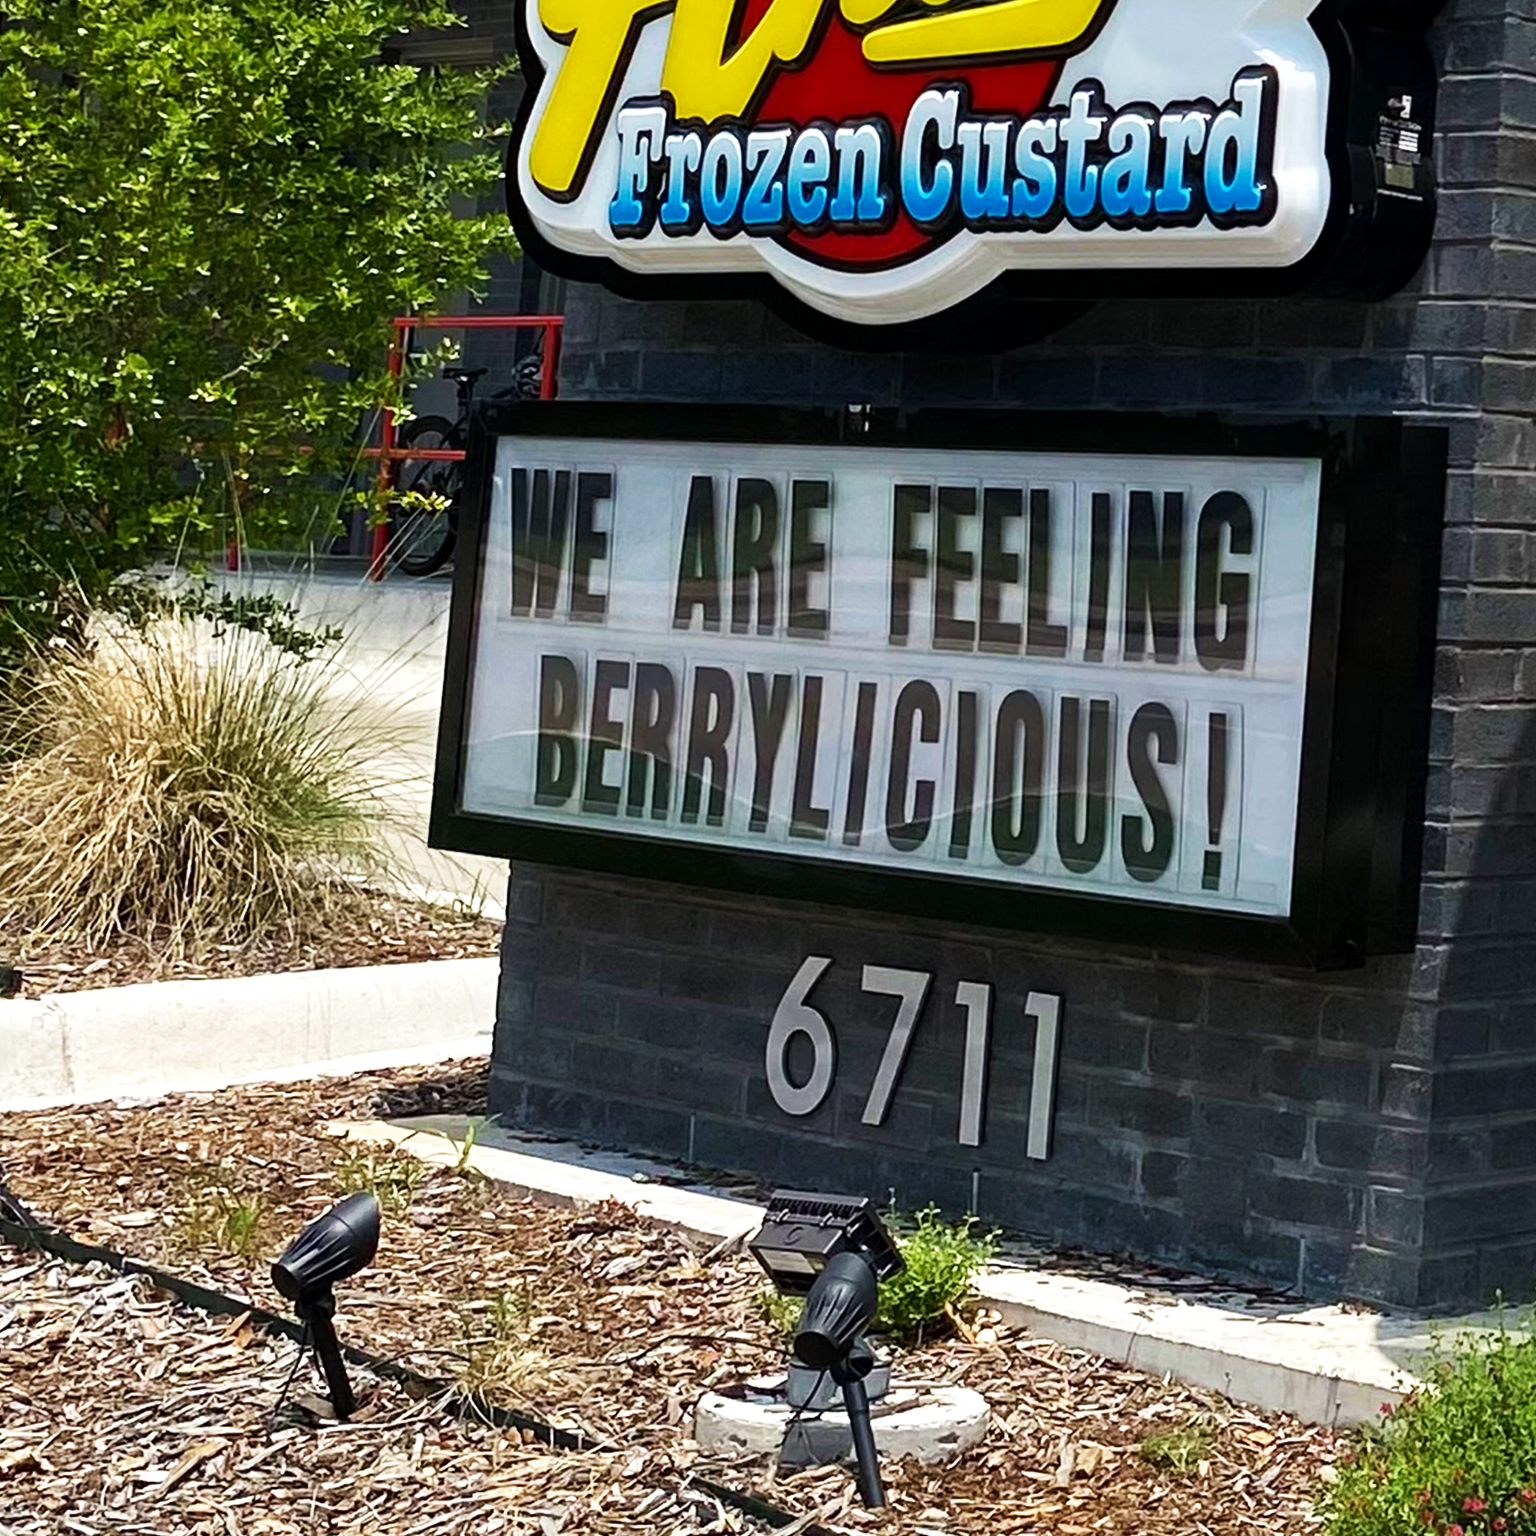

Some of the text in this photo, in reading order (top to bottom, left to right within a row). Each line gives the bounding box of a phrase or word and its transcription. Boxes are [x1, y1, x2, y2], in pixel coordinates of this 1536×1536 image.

[612, 70, 1274, 236] Frozen Custard
[511, 467, 1254, 672] WE ARE FEELING
[534, 654, 1228, 891] BERRYLICIOUS!
[765, 956, 1063, 1161] 6711
